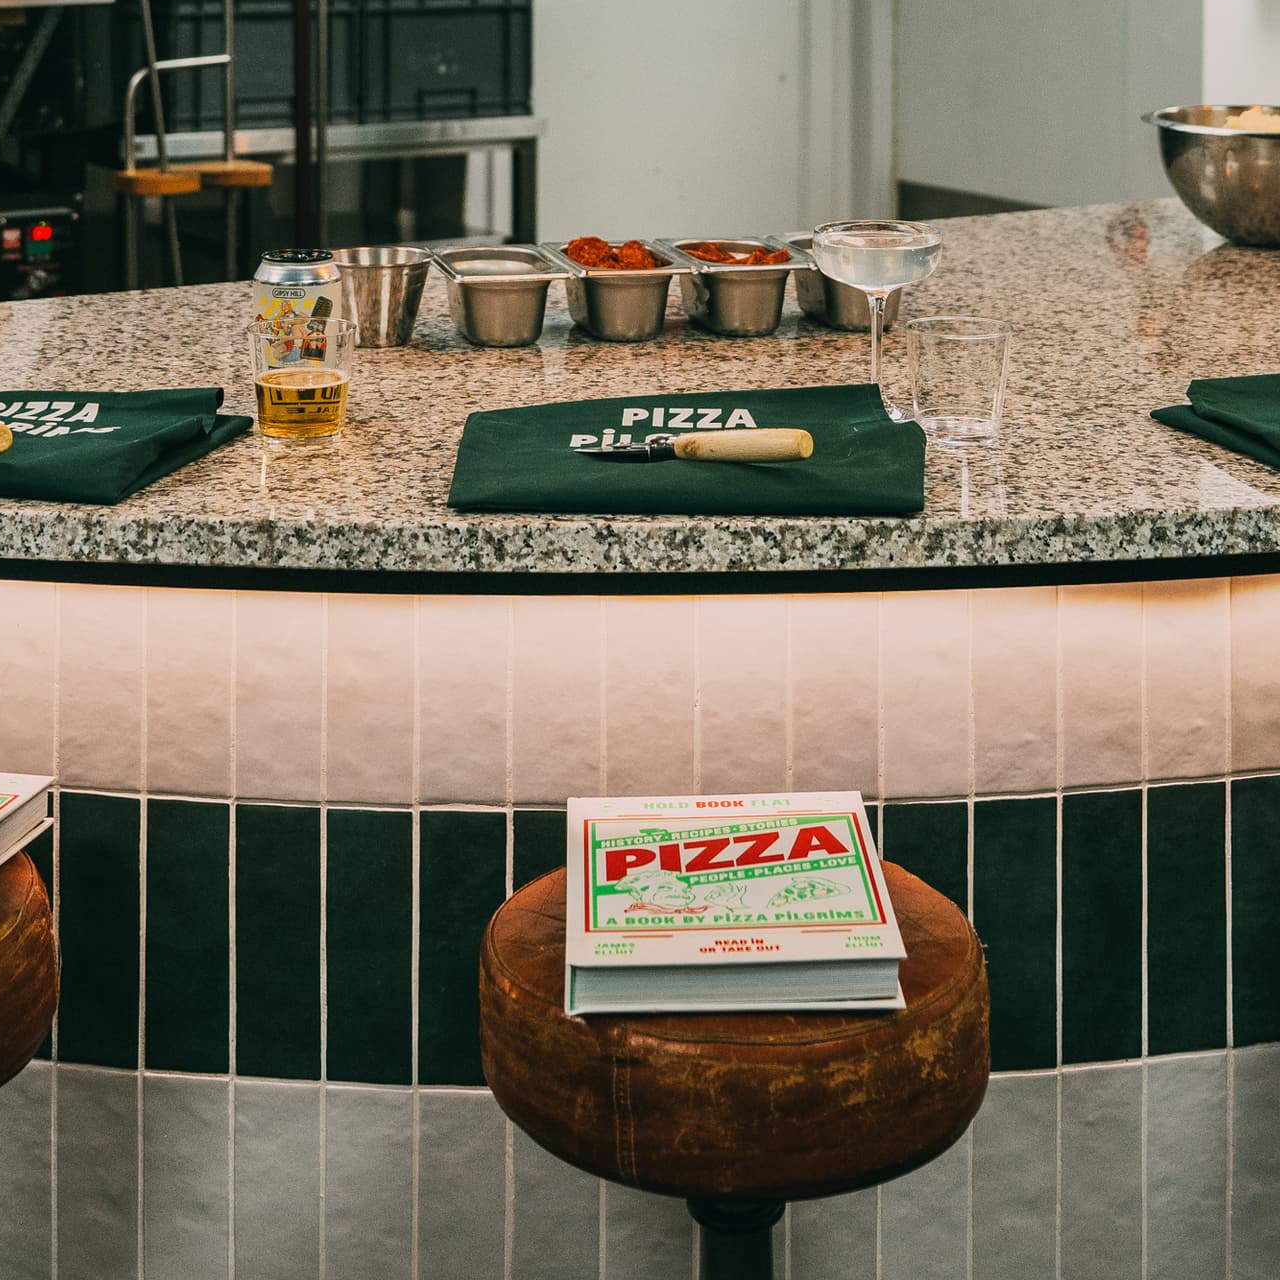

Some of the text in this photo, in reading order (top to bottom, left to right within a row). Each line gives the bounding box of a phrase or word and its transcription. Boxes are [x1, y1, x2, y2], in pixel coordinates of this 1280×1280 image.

[621, 407, 758, 429] PIZZA
[644, 799, 792, 810] HOLD BOOK FLAT
[601, 818, 798, 848] HISTORY RECIPES STORIES
[605, 825, 850, 882] PIZZA
[689, 856, 857, 885] PEOPLE PLACES LOVE
[625, 916, 674, 925] BOOK
[683, 915, 705, 924] BY
[721, 945, 753, 953] TAKE
